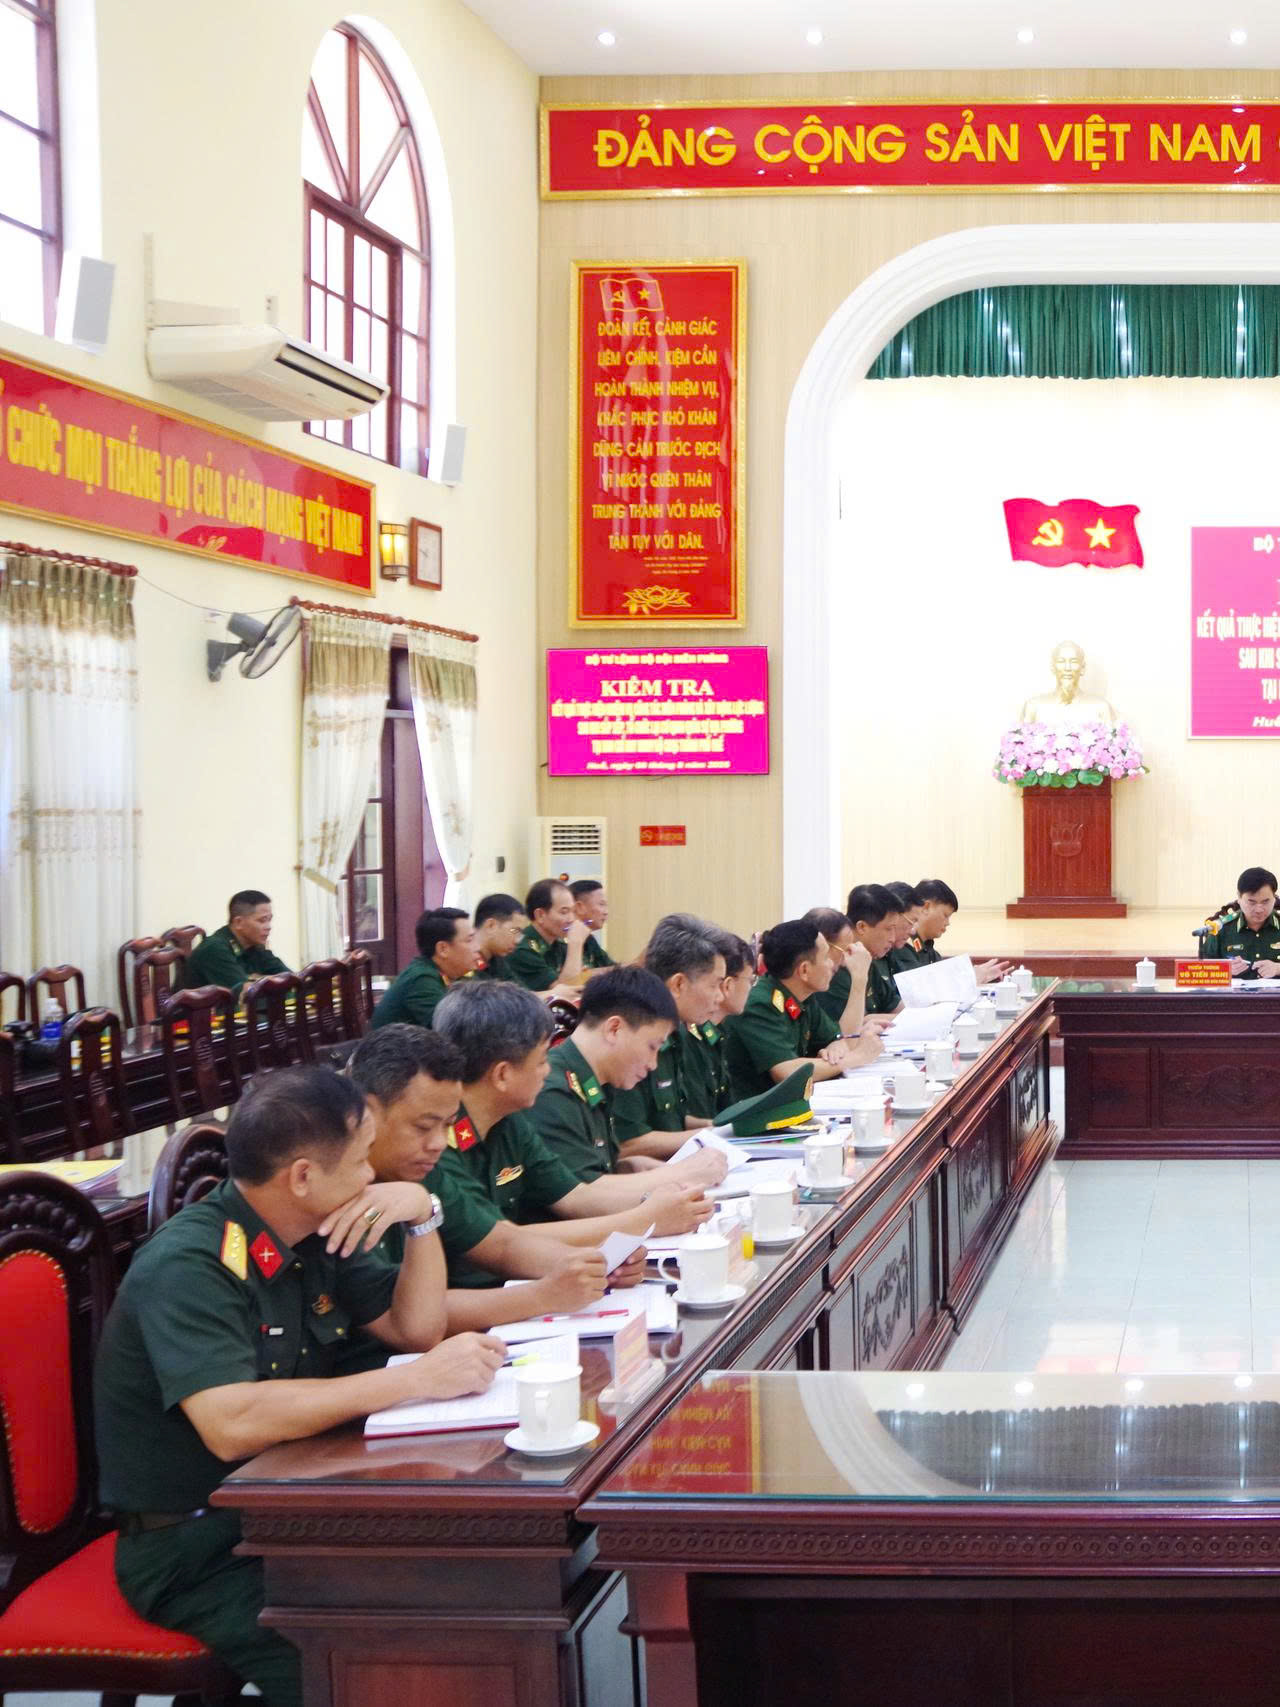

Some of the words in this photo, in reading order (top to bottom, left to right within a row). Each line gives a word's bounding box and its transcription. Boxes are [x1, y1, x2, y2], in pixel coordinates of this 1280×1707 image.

[594, 115, 736, 167] ĐẢNG
[754, 115, 906, 173] CỘNG
[925, 111, 1018, 164] SẢN
[1046, 114, 1130, 171] VIỆT
[1150, 123, 1261, 163] NAM
[7, 403, 62, 476] CHỨC
[65, 424, 103, 495] MỌI
[105, 425, 162, 503] THẮNG
[165, 455, 190, 518] LỢI
[193, 451, 225, 519] CỦA
[227, 468, 265, 530] CÁCH
[266, 486, 305, 544] MẠNG
[305, 495, 331, 554] VIỆT
[600, 675, 663, 697] KIỂM
[666, 679, 715, 697] TRA
